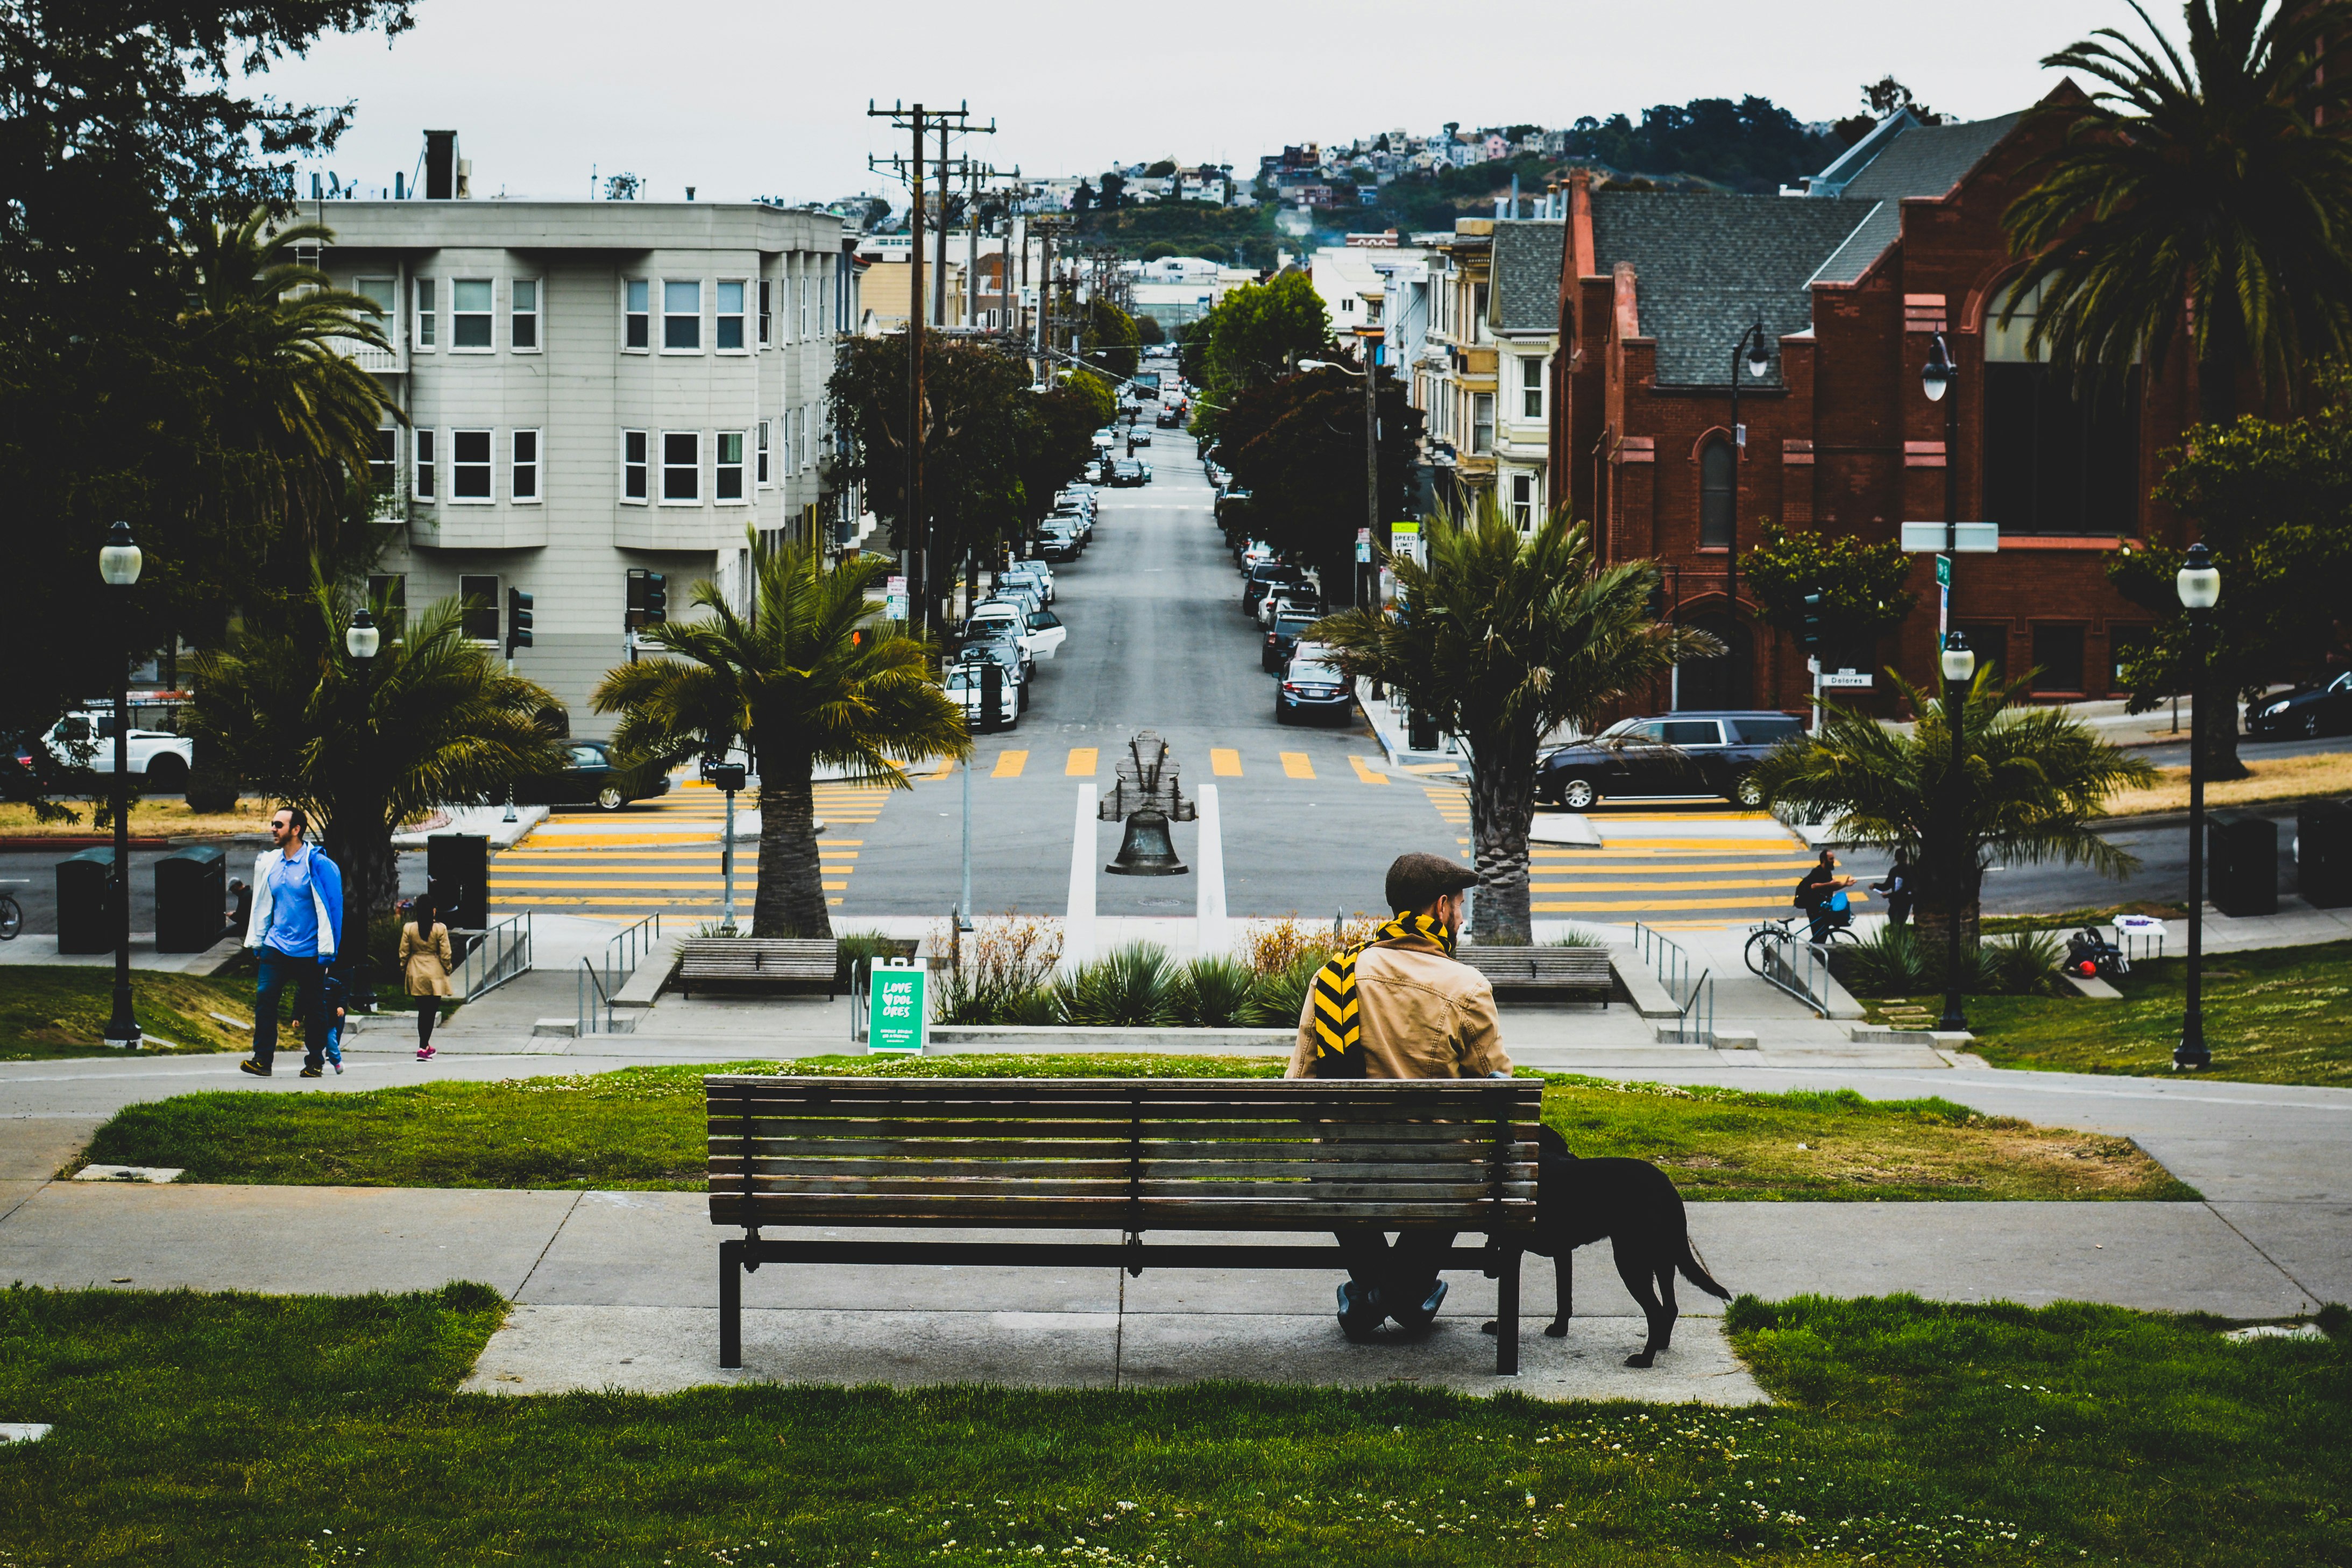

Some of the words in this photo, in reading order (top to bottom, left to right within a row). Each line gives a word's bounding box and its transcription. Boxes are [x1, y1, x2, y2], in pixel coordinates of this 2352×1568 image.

[1397, 549, 1412, 559] 15
[883, 982, 913, 994] LOVE
[893, 994, 913, 1006] DOL
[882, 1006, 910, 1018] ORES
